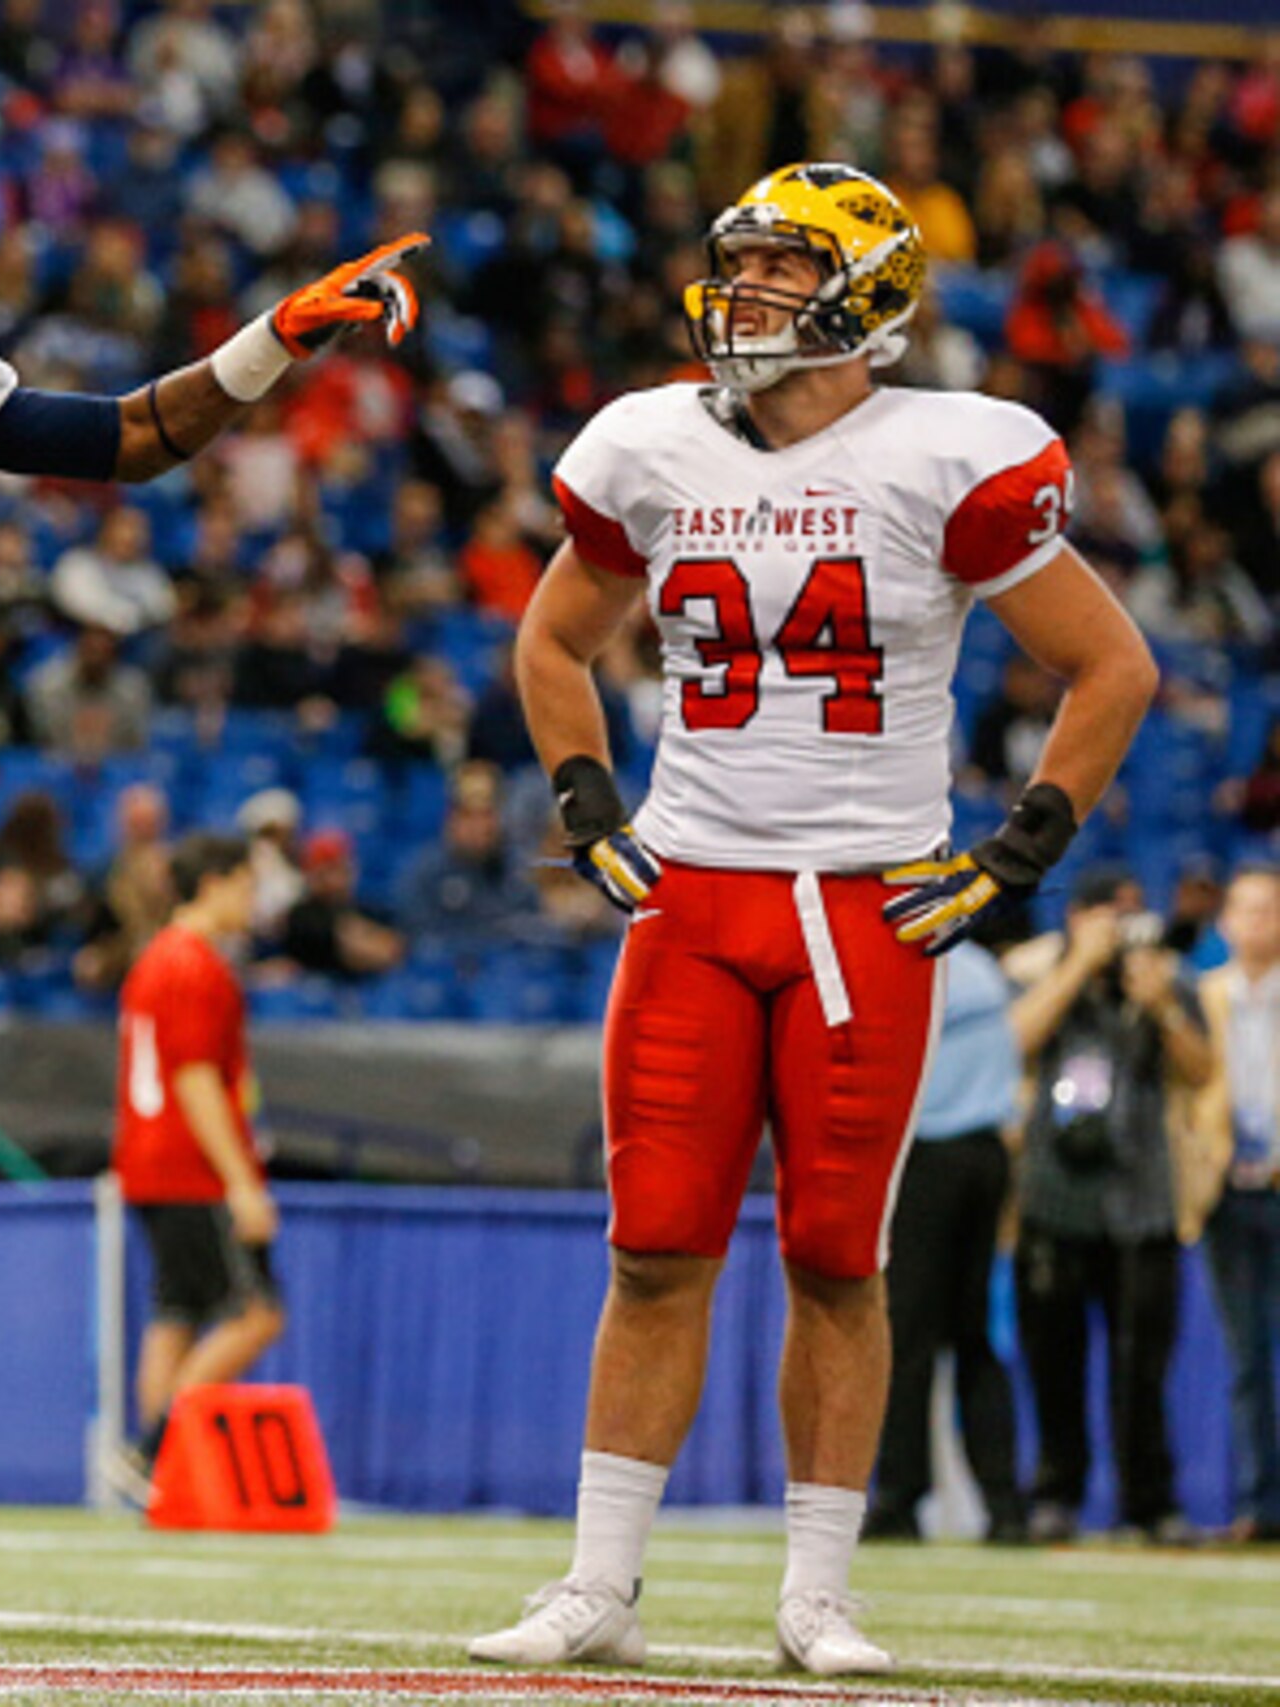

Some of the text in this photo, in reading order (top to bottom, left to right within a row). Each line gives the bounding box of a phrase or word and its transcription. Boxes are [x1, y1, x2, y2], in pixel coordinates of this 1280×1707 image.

[672, 507, 859, 536] EAST WEST
[658, 556, 885, 735] 34
[214, 1411, 307, 1508] 10
